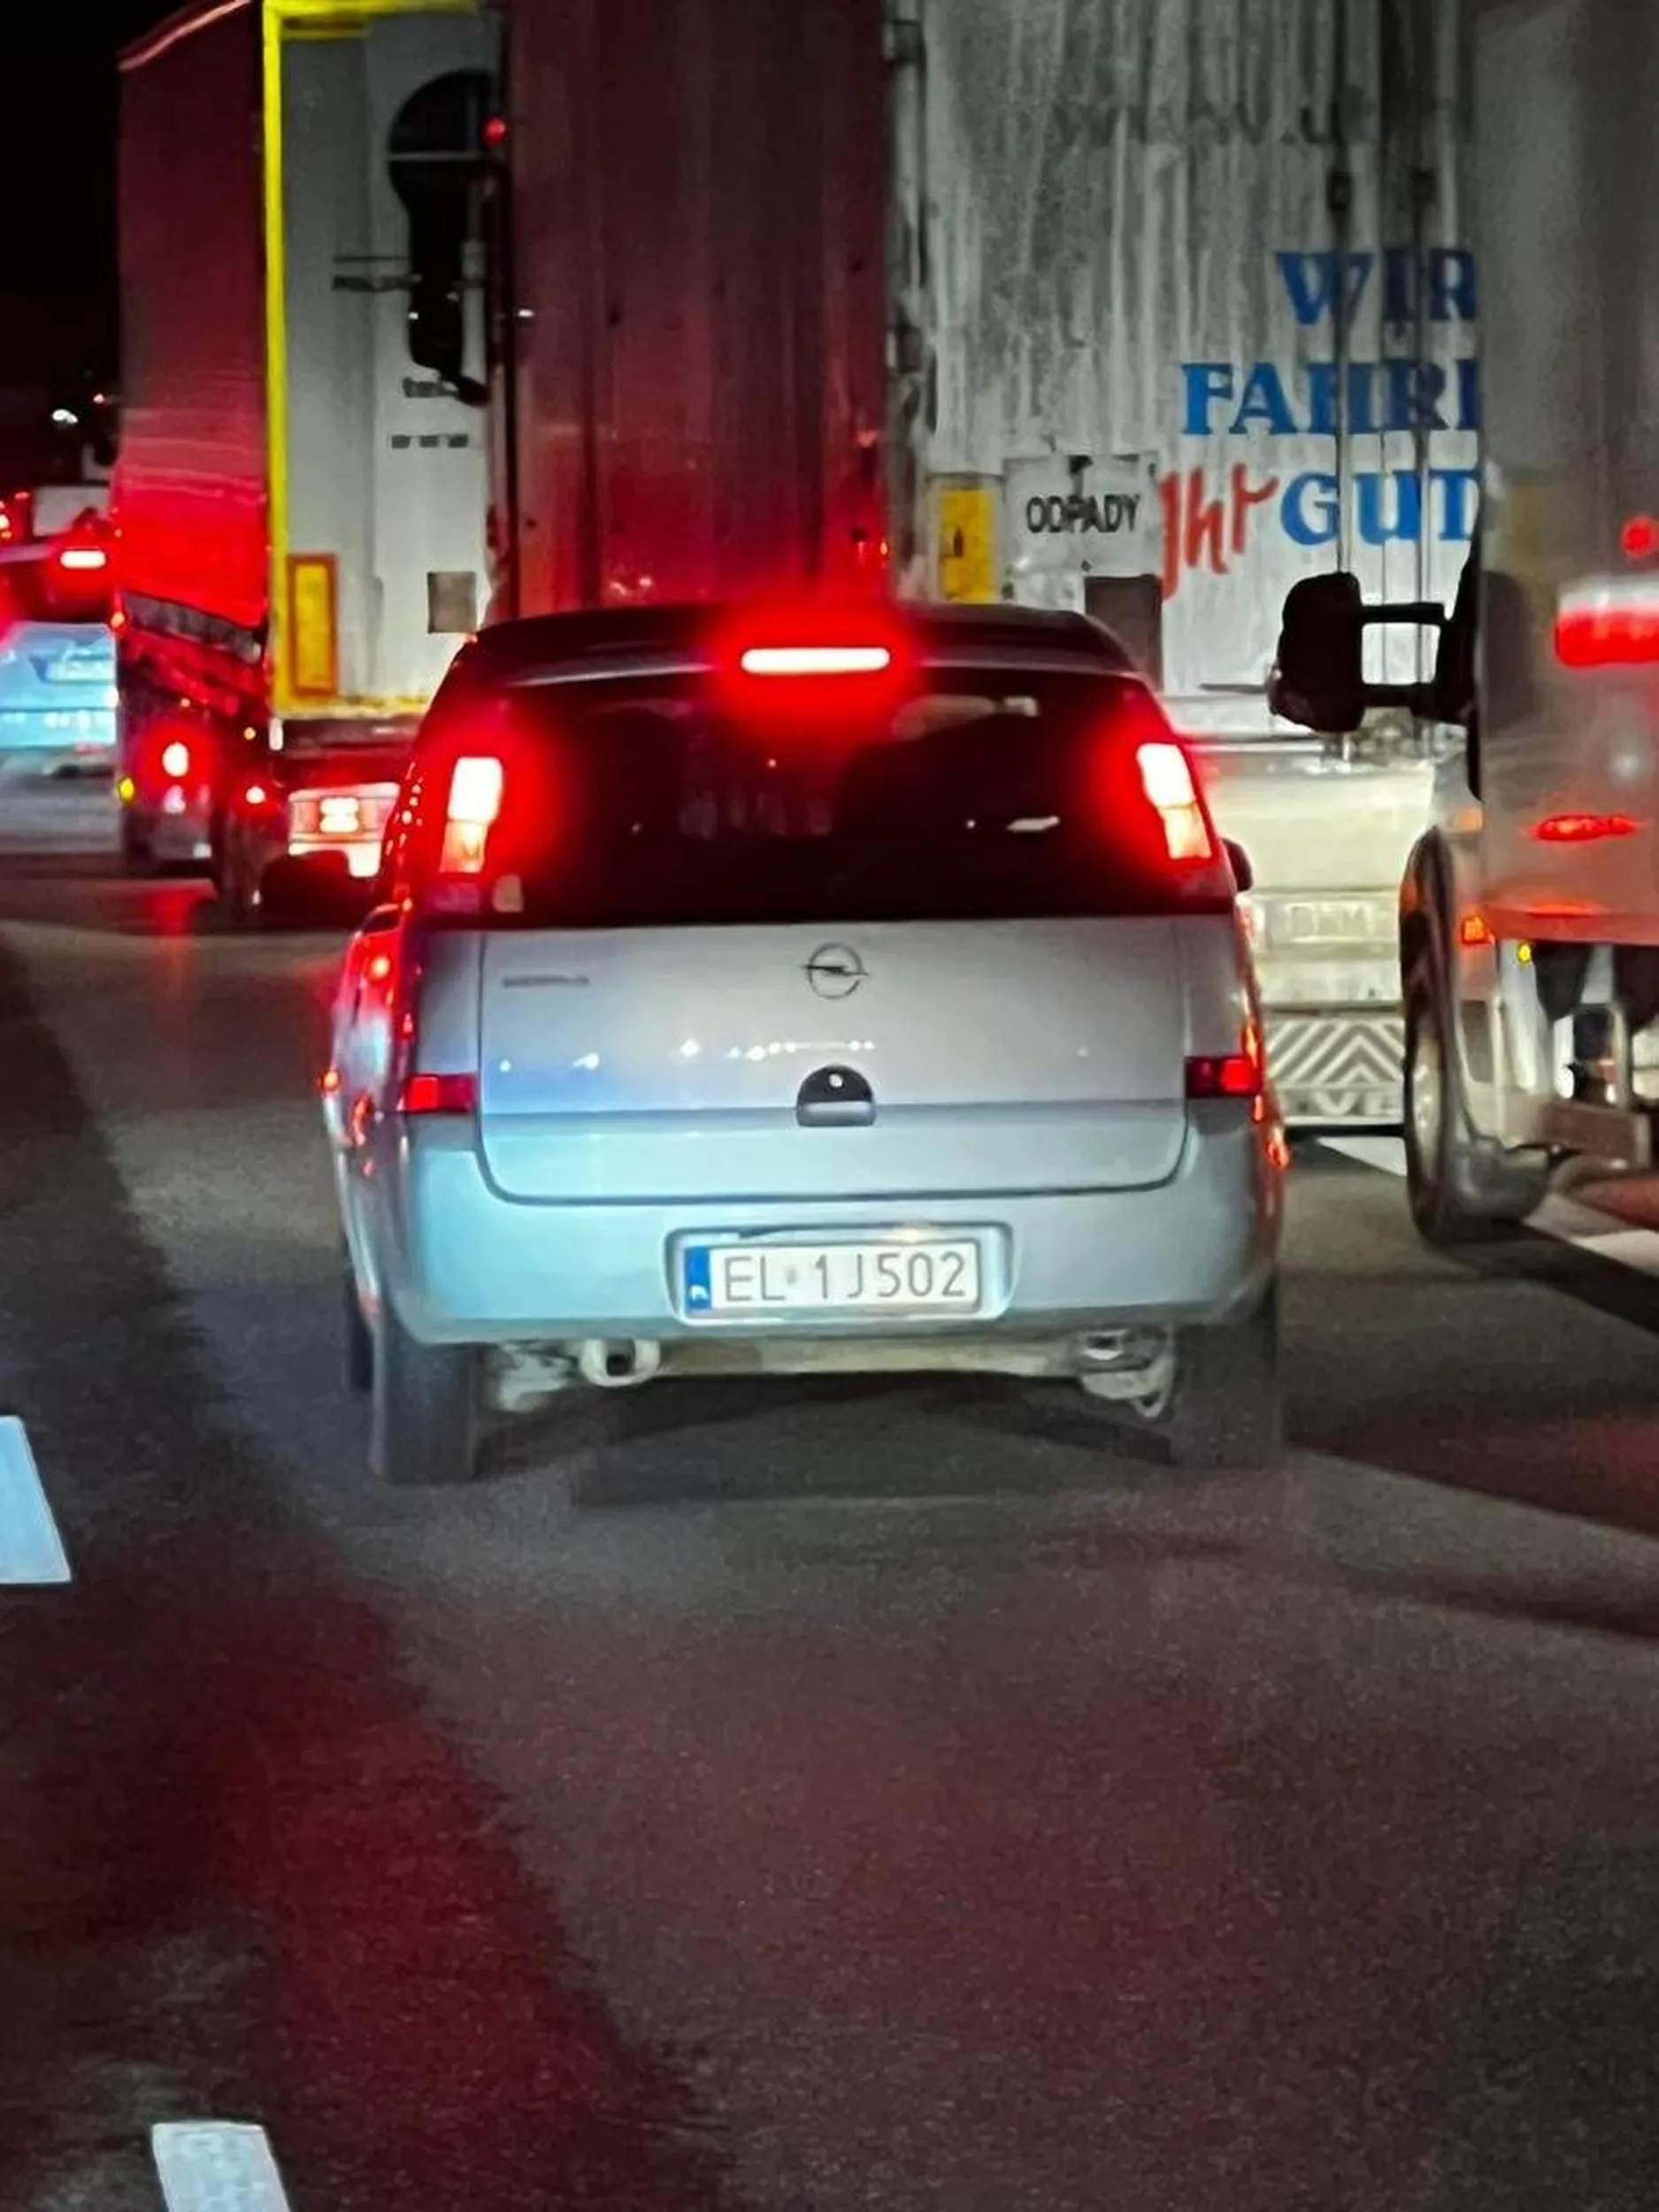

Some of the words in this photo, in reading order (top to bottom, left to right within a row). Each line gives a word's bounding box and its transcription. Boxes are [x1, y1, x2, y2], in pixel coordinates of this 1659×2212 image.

[1275, 250, 1475, 326] WIR
[724, 1255, 786, 1302] EL
[815, 1251, 967, 1300] 1J502
